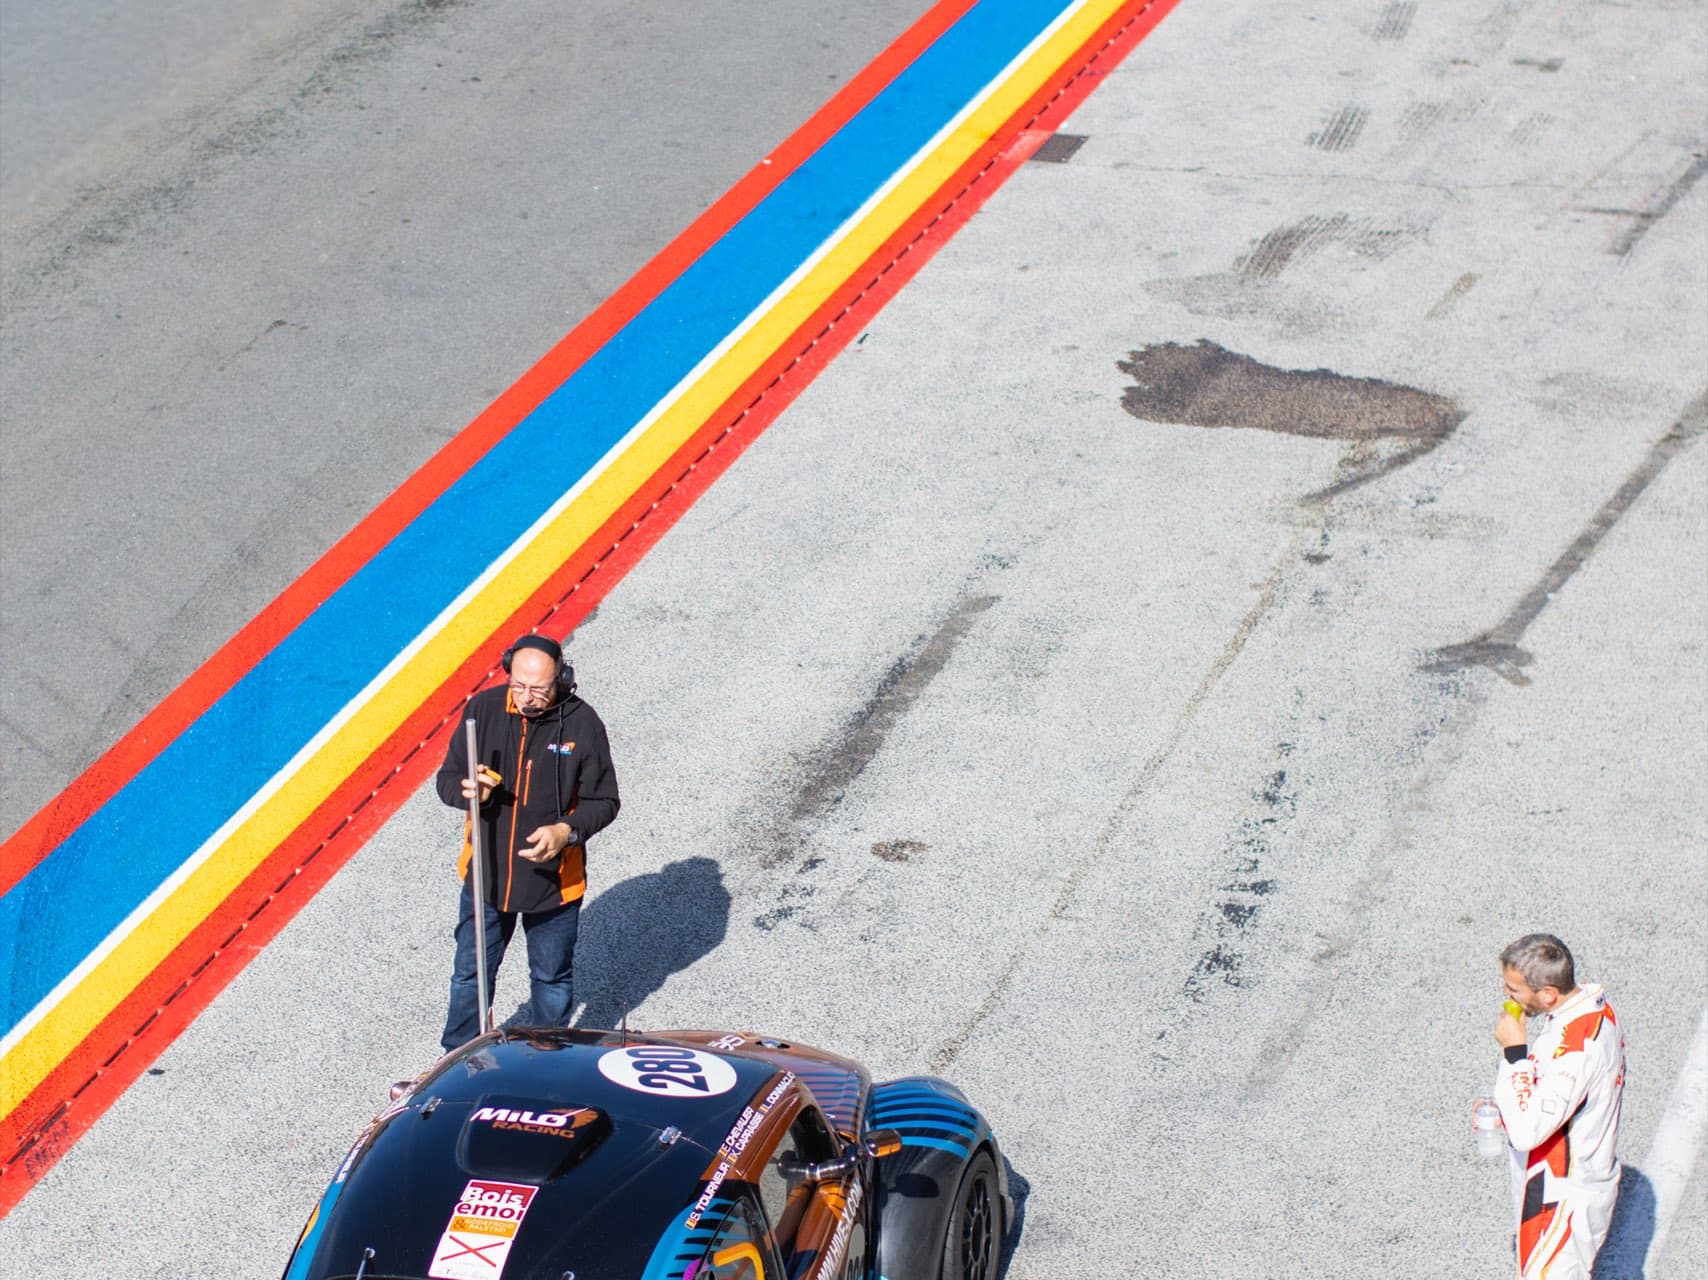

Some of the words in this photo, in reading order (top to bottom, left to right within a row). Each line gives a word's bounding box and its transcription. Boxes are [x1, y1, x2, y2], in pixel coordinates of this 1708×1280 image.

[626, 1046, 710, 1094] 280
[492, 1121, 576, 1139] RACING
[461, 1186, 524, 1207] Bois
[695, 1161, 731, 1213] TOURNEUR
